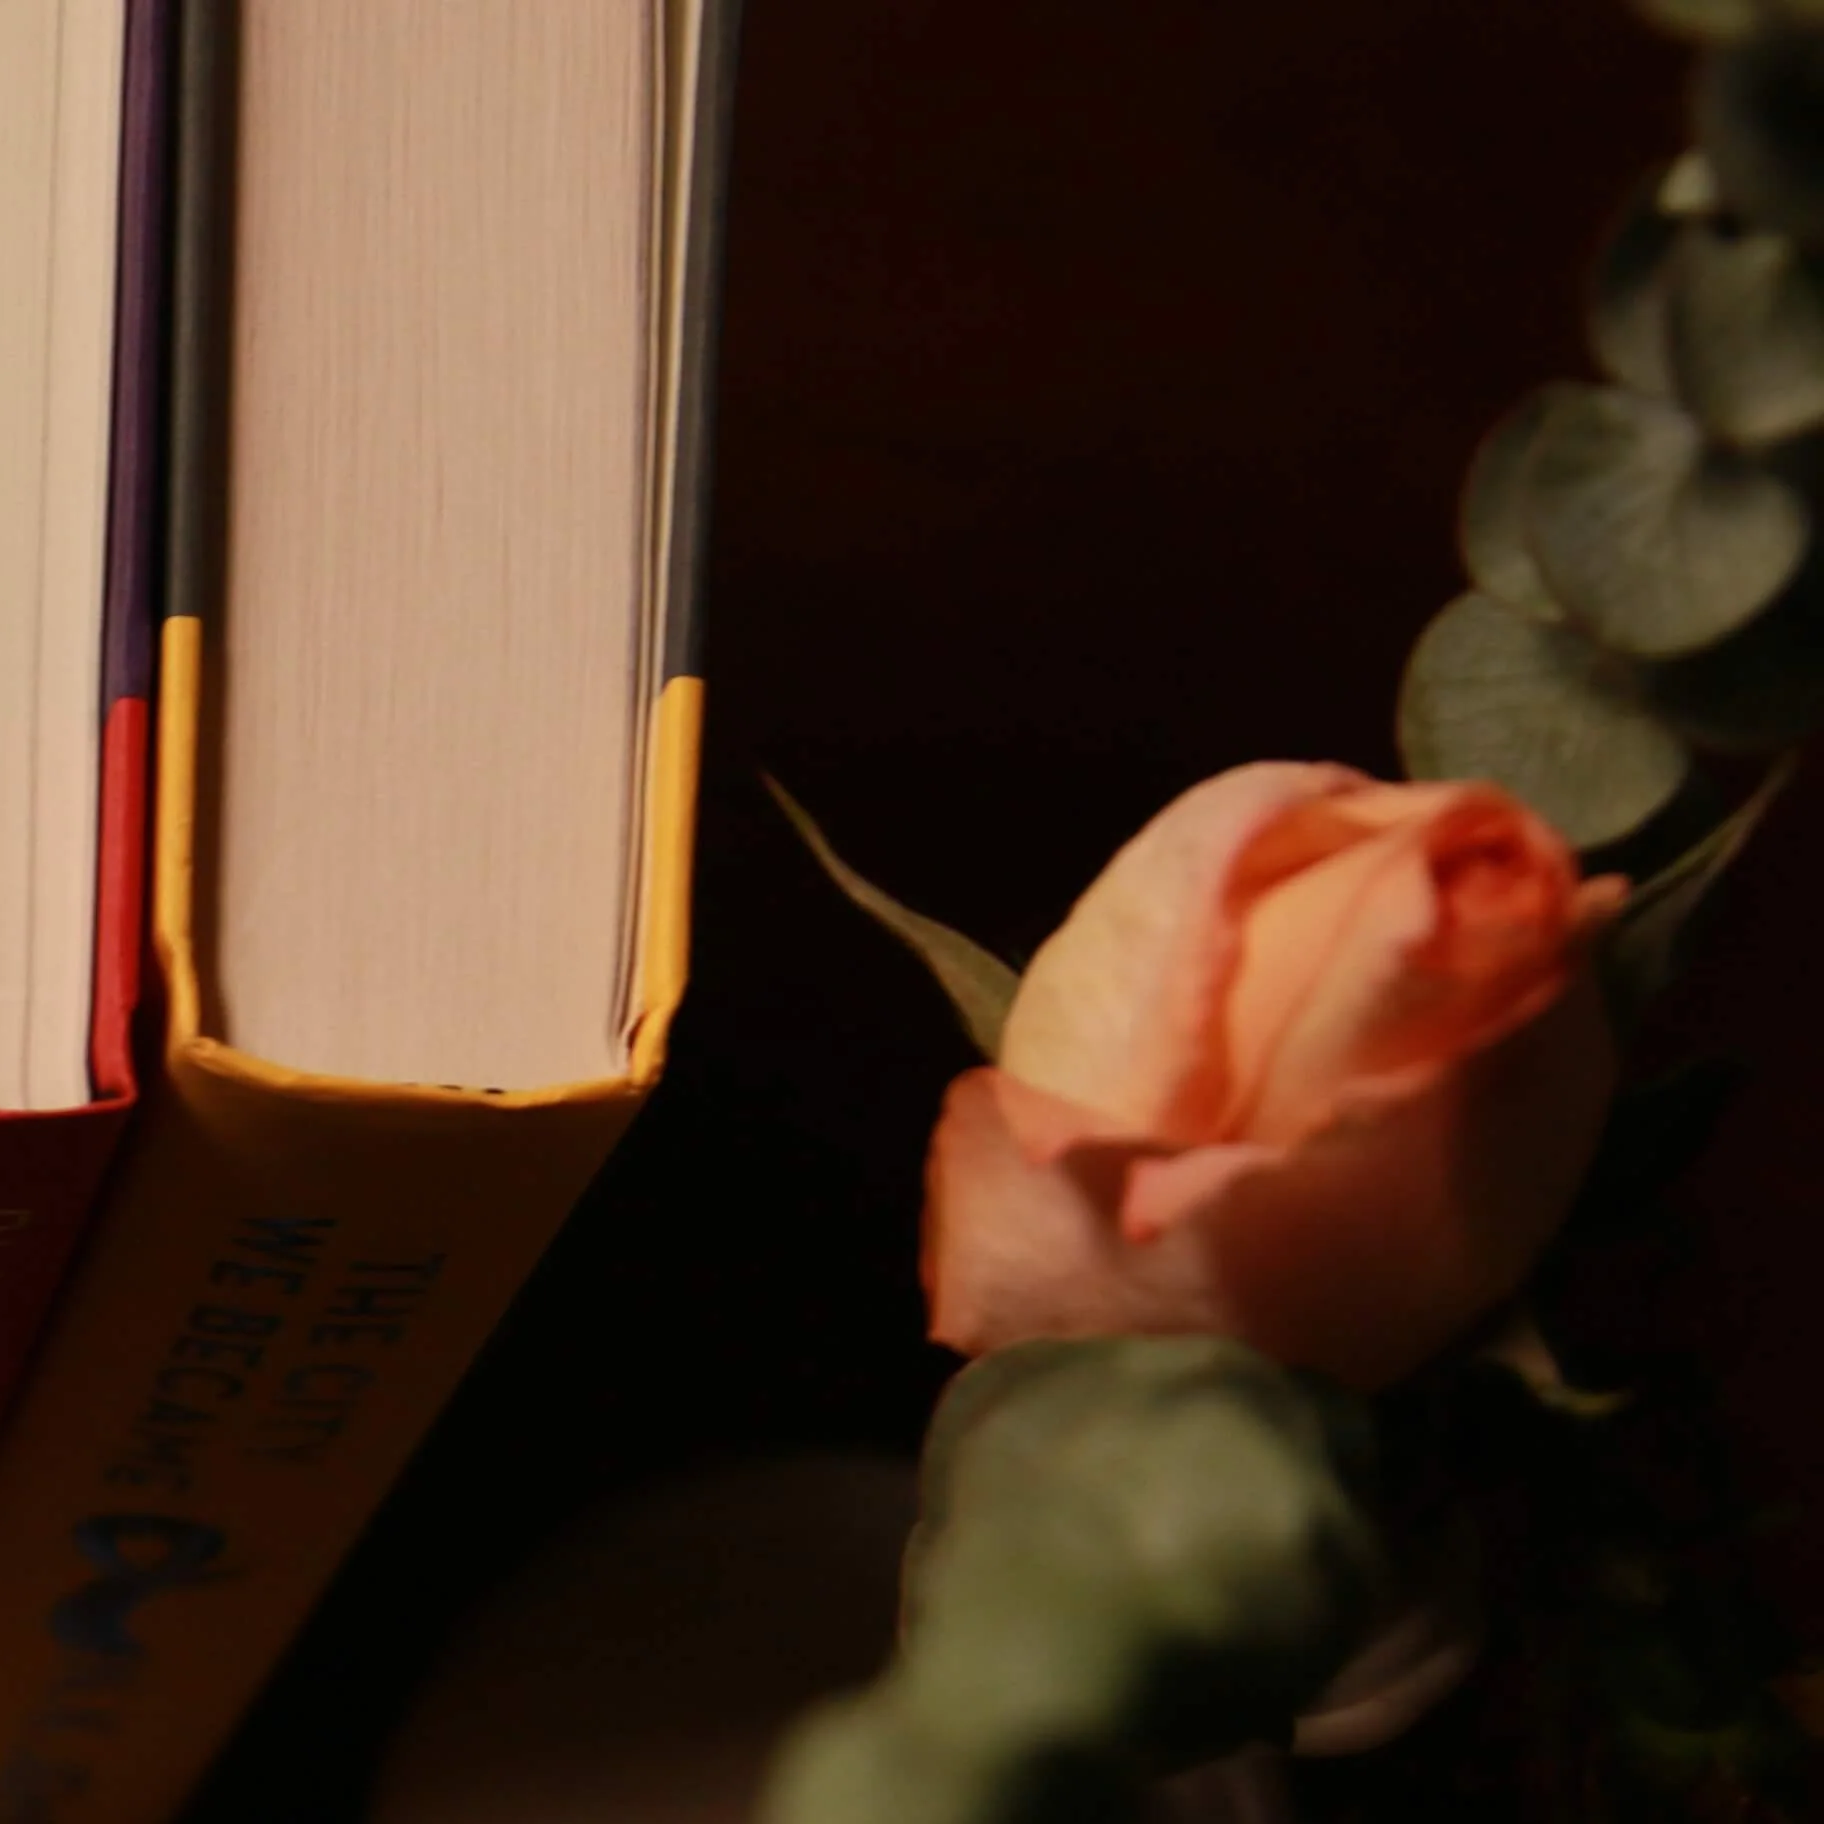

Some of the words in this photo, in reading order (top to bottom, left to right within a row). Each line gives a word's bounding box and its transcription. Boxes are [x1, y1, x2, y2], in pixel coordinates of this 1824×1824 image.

[207, 1216, 338, 1297] WE
[310, 1251, 447, 1349] THE
[103, 1303, 284, 1495] BECAME
[248, 1364, 379, 1472] CITY
